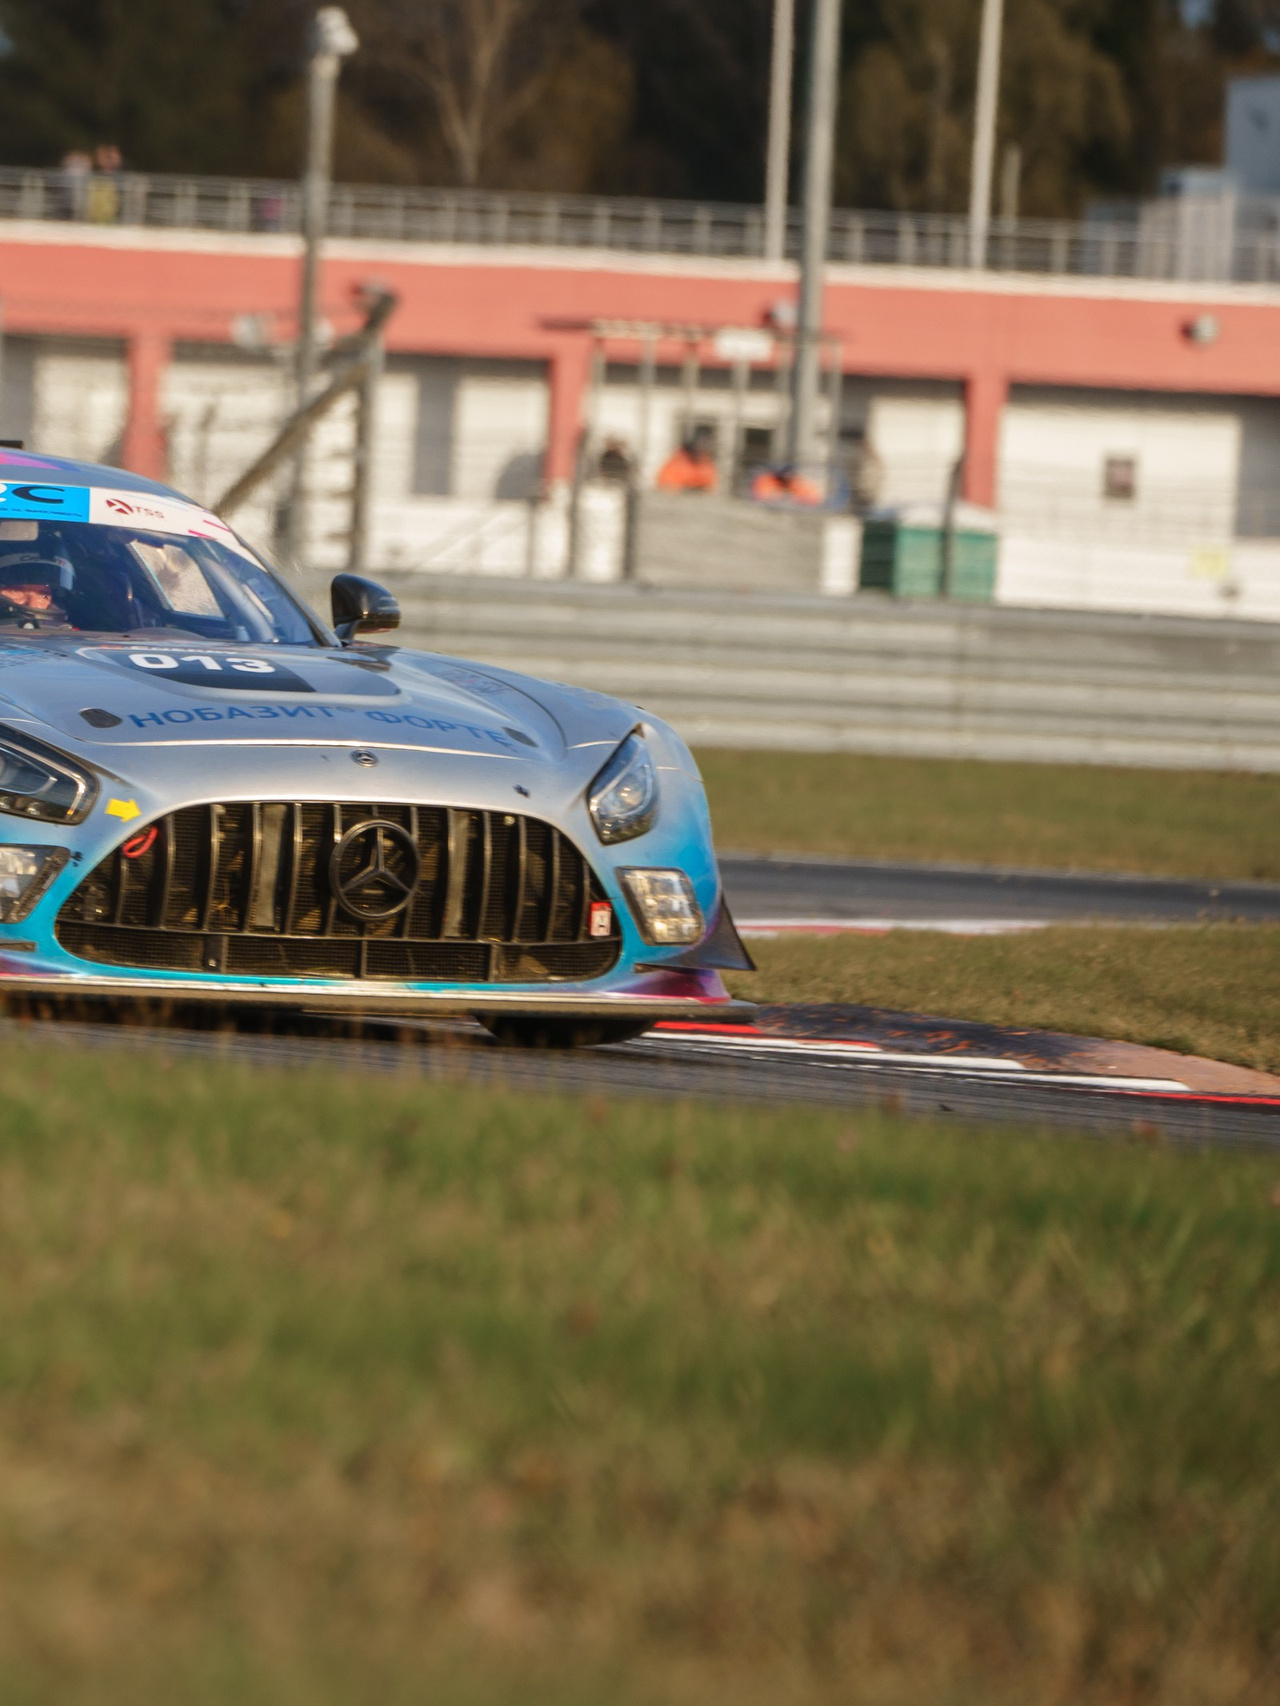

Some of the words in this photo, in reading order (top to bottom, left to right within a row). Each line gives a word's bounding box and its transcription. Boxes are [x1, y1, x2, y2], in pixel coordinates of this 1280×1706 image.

[136, 506, 165, 519] TSS
[128, 653, 276, 673] 013
[366, 710, 515, 748] ФОРТЕ
